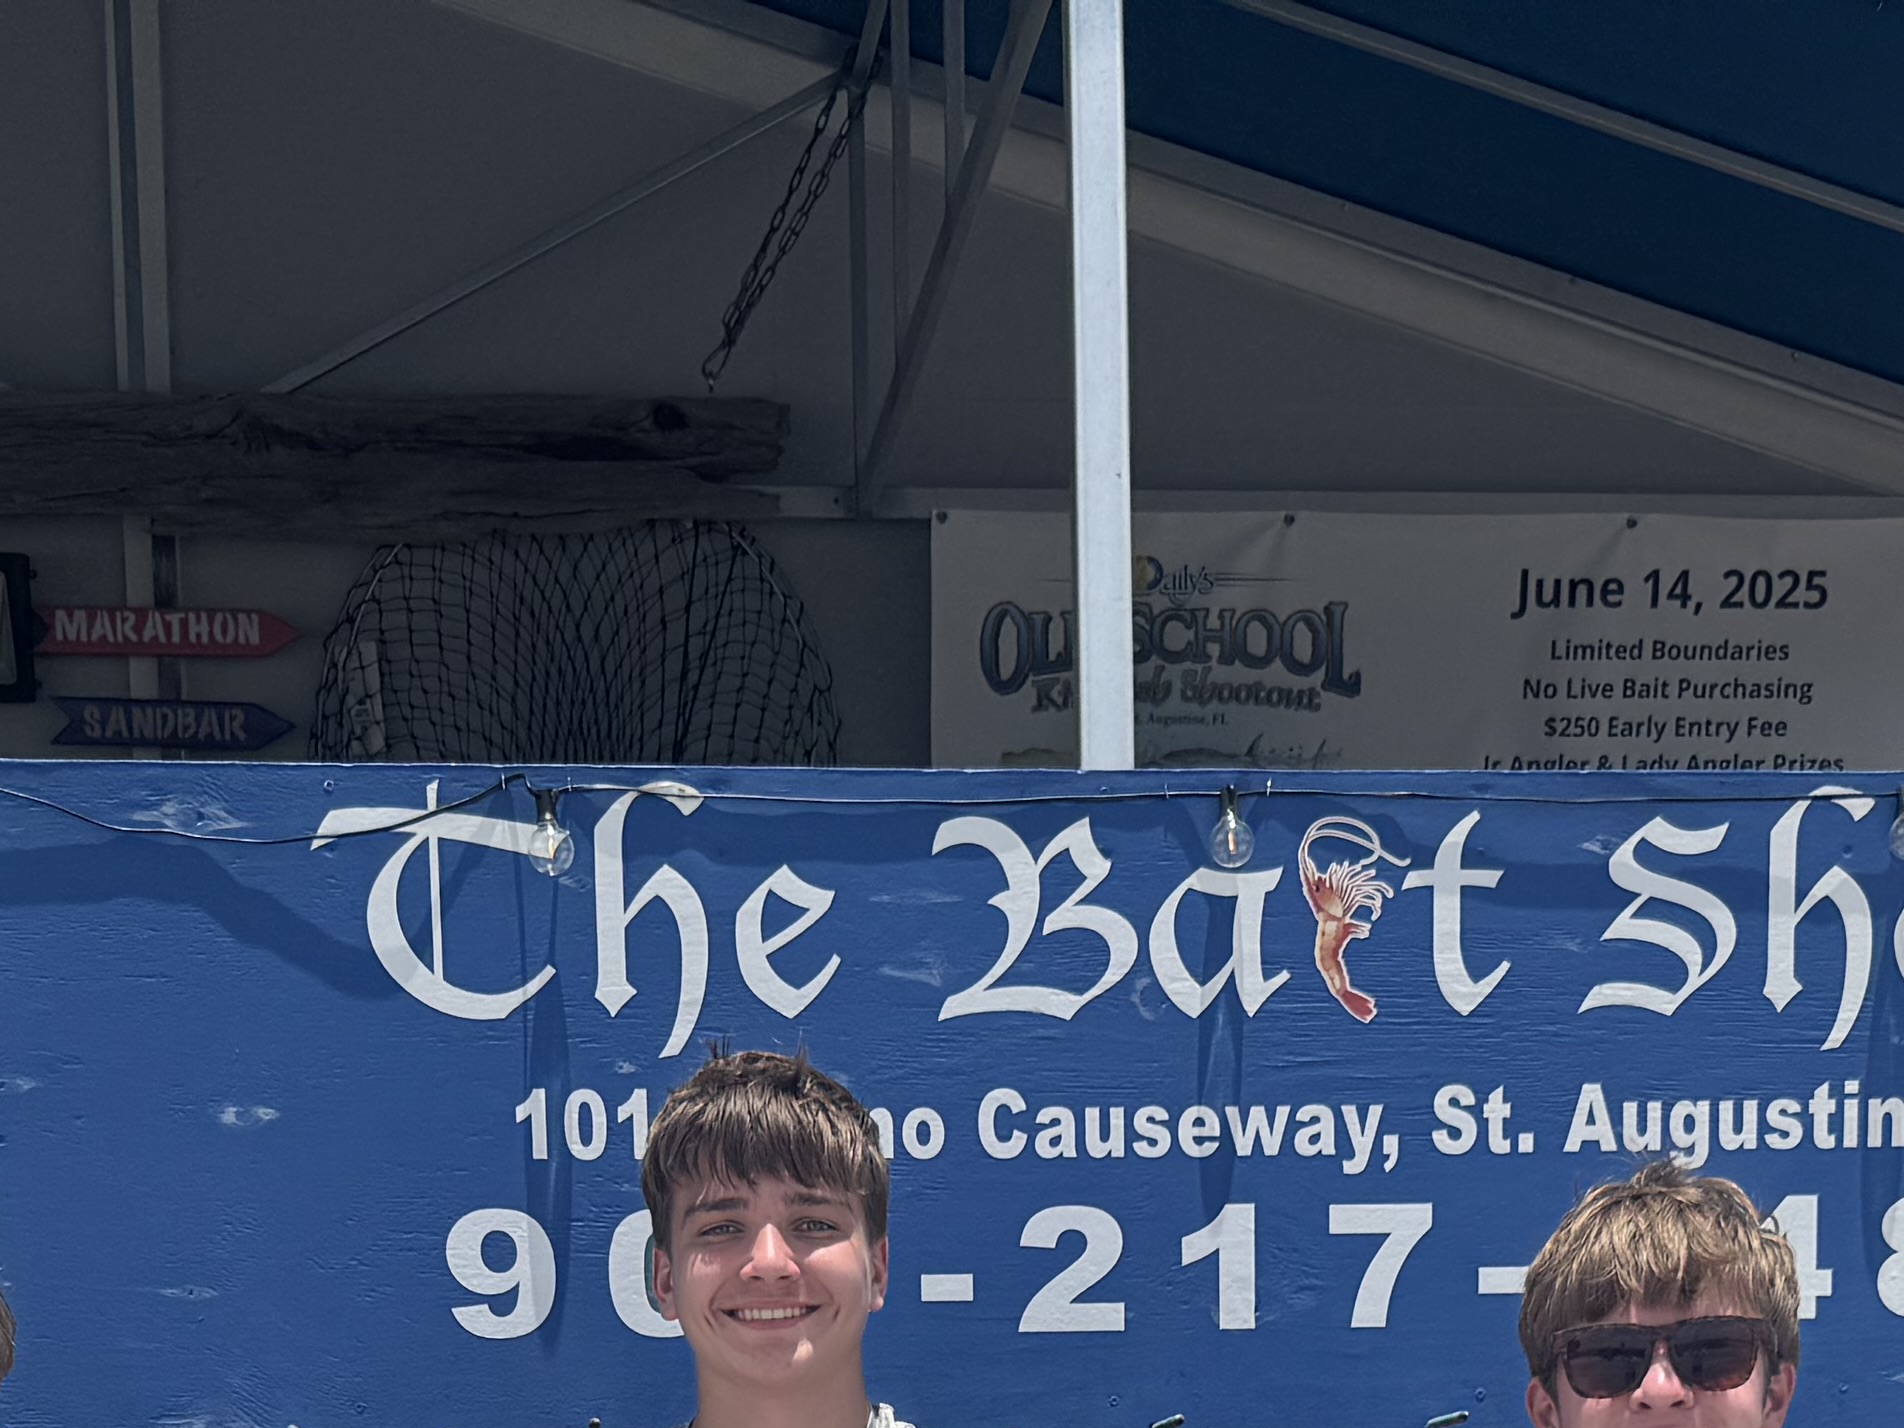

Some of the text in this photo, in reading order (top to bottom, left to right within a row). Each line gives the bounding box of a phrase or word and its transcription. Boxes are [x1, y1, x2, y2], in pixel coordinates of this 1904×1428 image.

[1509, 568, 1829, 620] June 14, 2025
[53, 608, 261, 646] MARATHON
[980, 601, 1075, 696] OL
[1550, 639, 1790, 662] Limited Boundaries
[1522, 677, 1814, 705] No Live Bait Purchasing
[82, 704, 247, 742] SANDBAR
[1544, 715, 1788, 744] $250 Early Entry Fee
[1773, 753, 1845, 773] Prizes
[308, 777, 841, 1060] The
[977, 1086, 1400, 1174] Causeway,
[1432, 1085, 1535, 1157] St.
